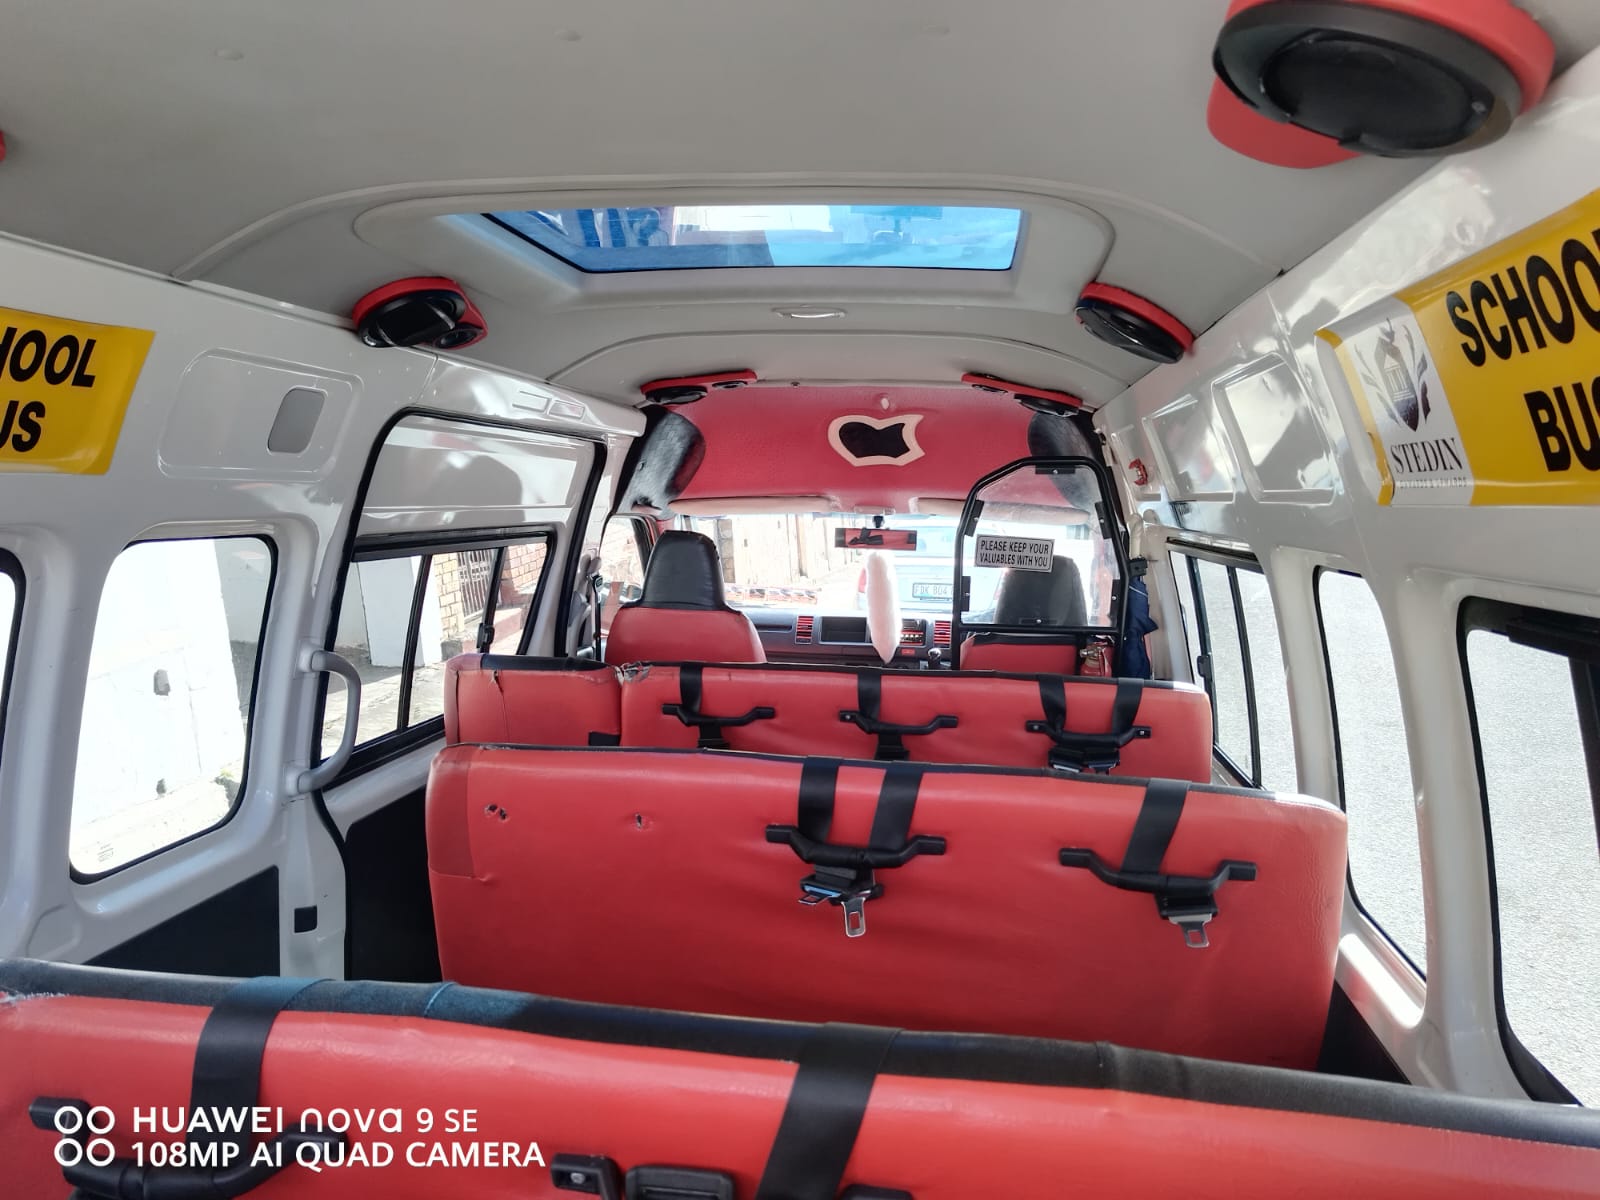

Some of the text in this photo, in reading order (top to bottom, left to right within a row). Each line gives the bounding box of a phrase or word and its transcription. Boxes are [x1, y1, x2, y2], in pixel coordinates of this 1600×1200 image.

[1446, 228, 1600, 367] SCHOO
[1524, 376, 1600, 472] BU
[1390, 437, 1463, 474] STEDIN
[980, 540, 1049, 554] PLEASE KEEP YOUR
[980, 552, 1048, 567] VALUABLES WITH YOU
